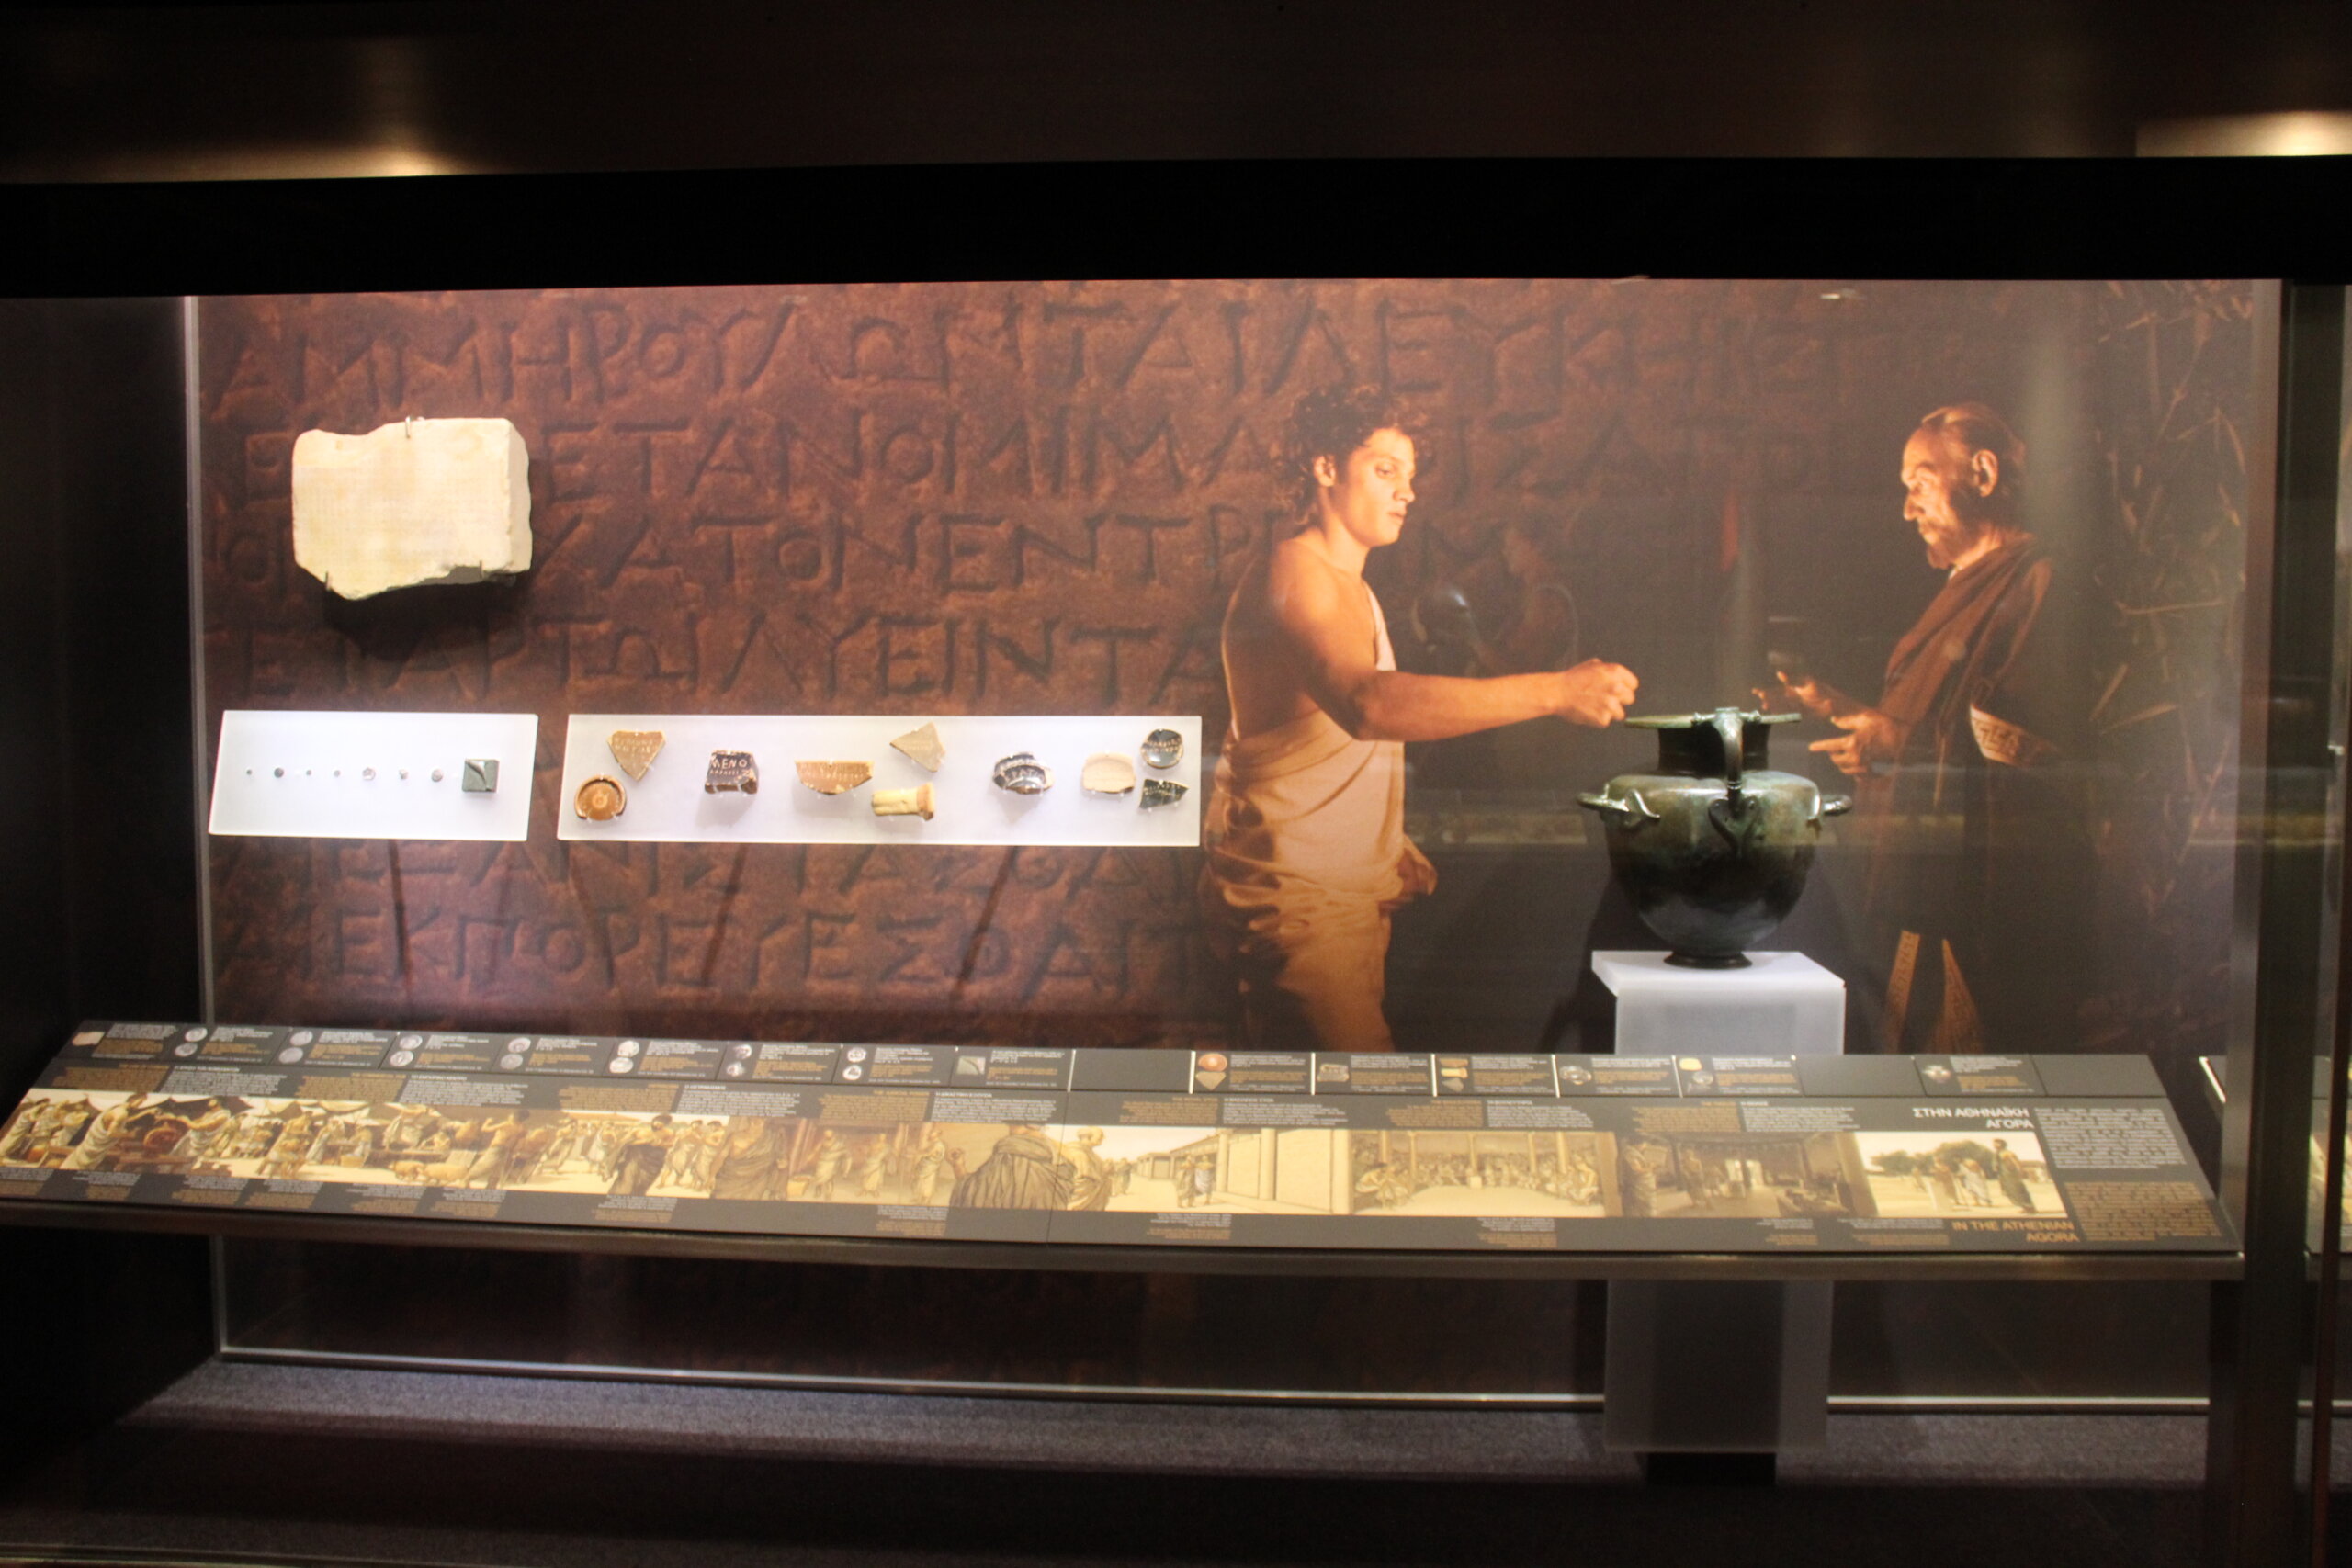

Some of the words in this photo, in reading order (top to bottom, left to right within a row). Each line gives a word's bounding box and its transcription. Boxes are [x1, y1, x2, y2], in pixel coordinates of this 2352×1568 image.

[1912, 1107, 1952, 1118] ΣΤΗΝ
[1985, 1118, 2035, 1129] ΑΓΟΡΑ
[1951, 1221, 1969, 1231] IN
[1971, 1221, 2000, 1231] THE
[2002, 1220, 2075, 1231] ATHENIAN
[2025, 1232, 2081, 1243] AGORA
